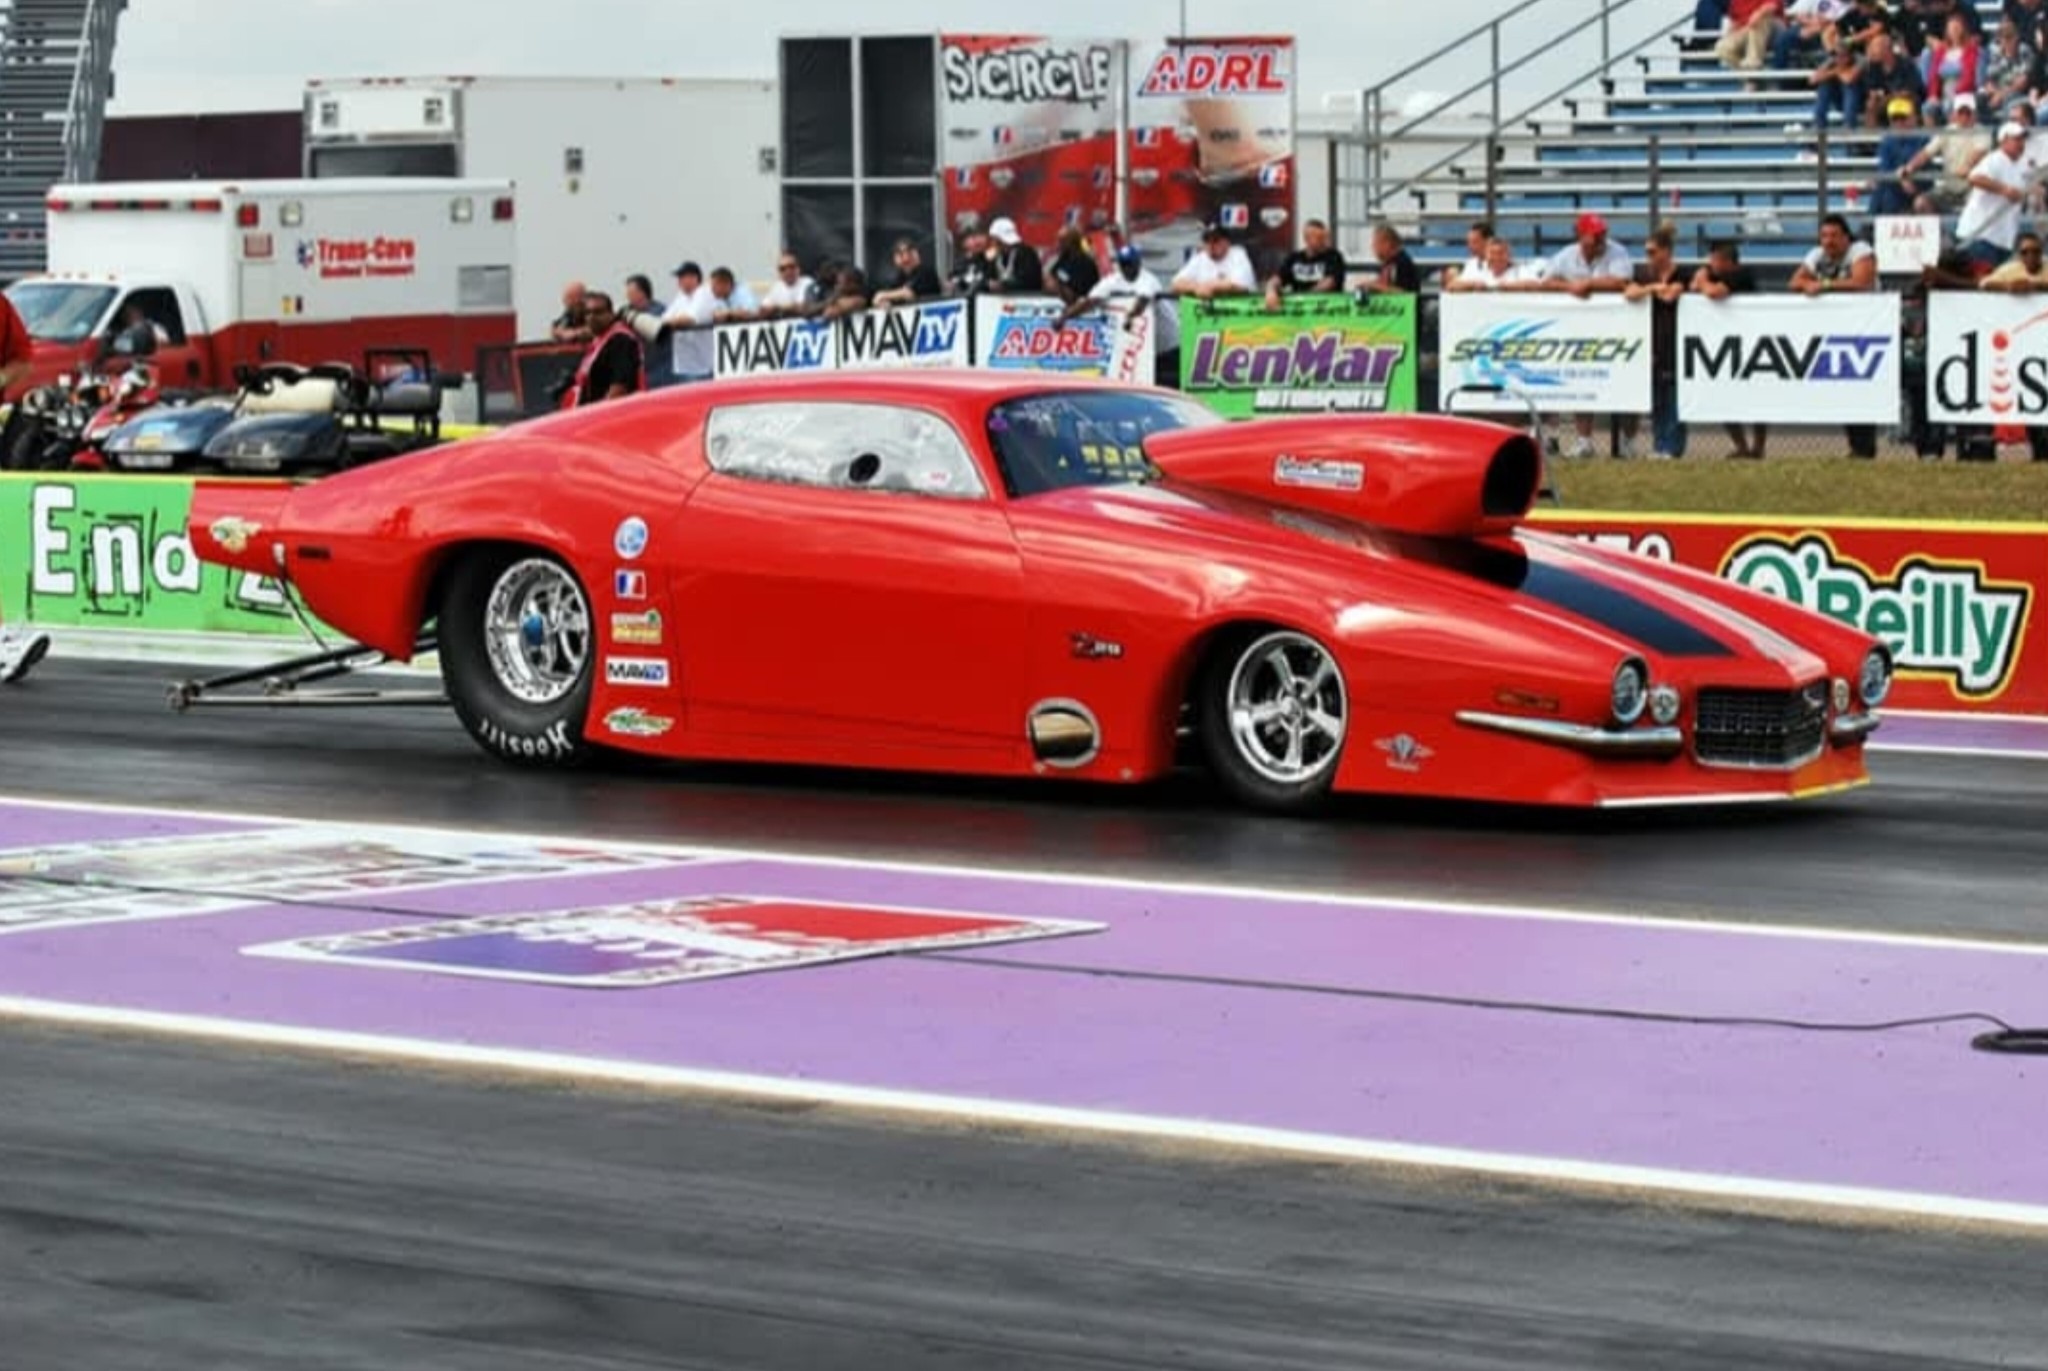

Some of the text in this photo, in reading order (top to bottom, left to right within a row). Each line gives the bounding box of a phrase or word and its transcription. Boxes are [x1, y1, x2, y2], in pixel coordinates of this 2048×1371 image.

[1145, 53, 1286, 92] ADRL
[317, 236, 415, 261] Trans-Care
[717, 319, 833, 374] MAVTV
[843, 304, 963, 362] MAVTV
[998, 327, 1102, 357] ADRL
[1448, 338, 1643, 363] SPEEDTECH
[1189, 330, 1404, 388] LenMar
[1683, 334, 1892, 380] MAVTV
[1734, 548, 2010, 678] O'Reilly
